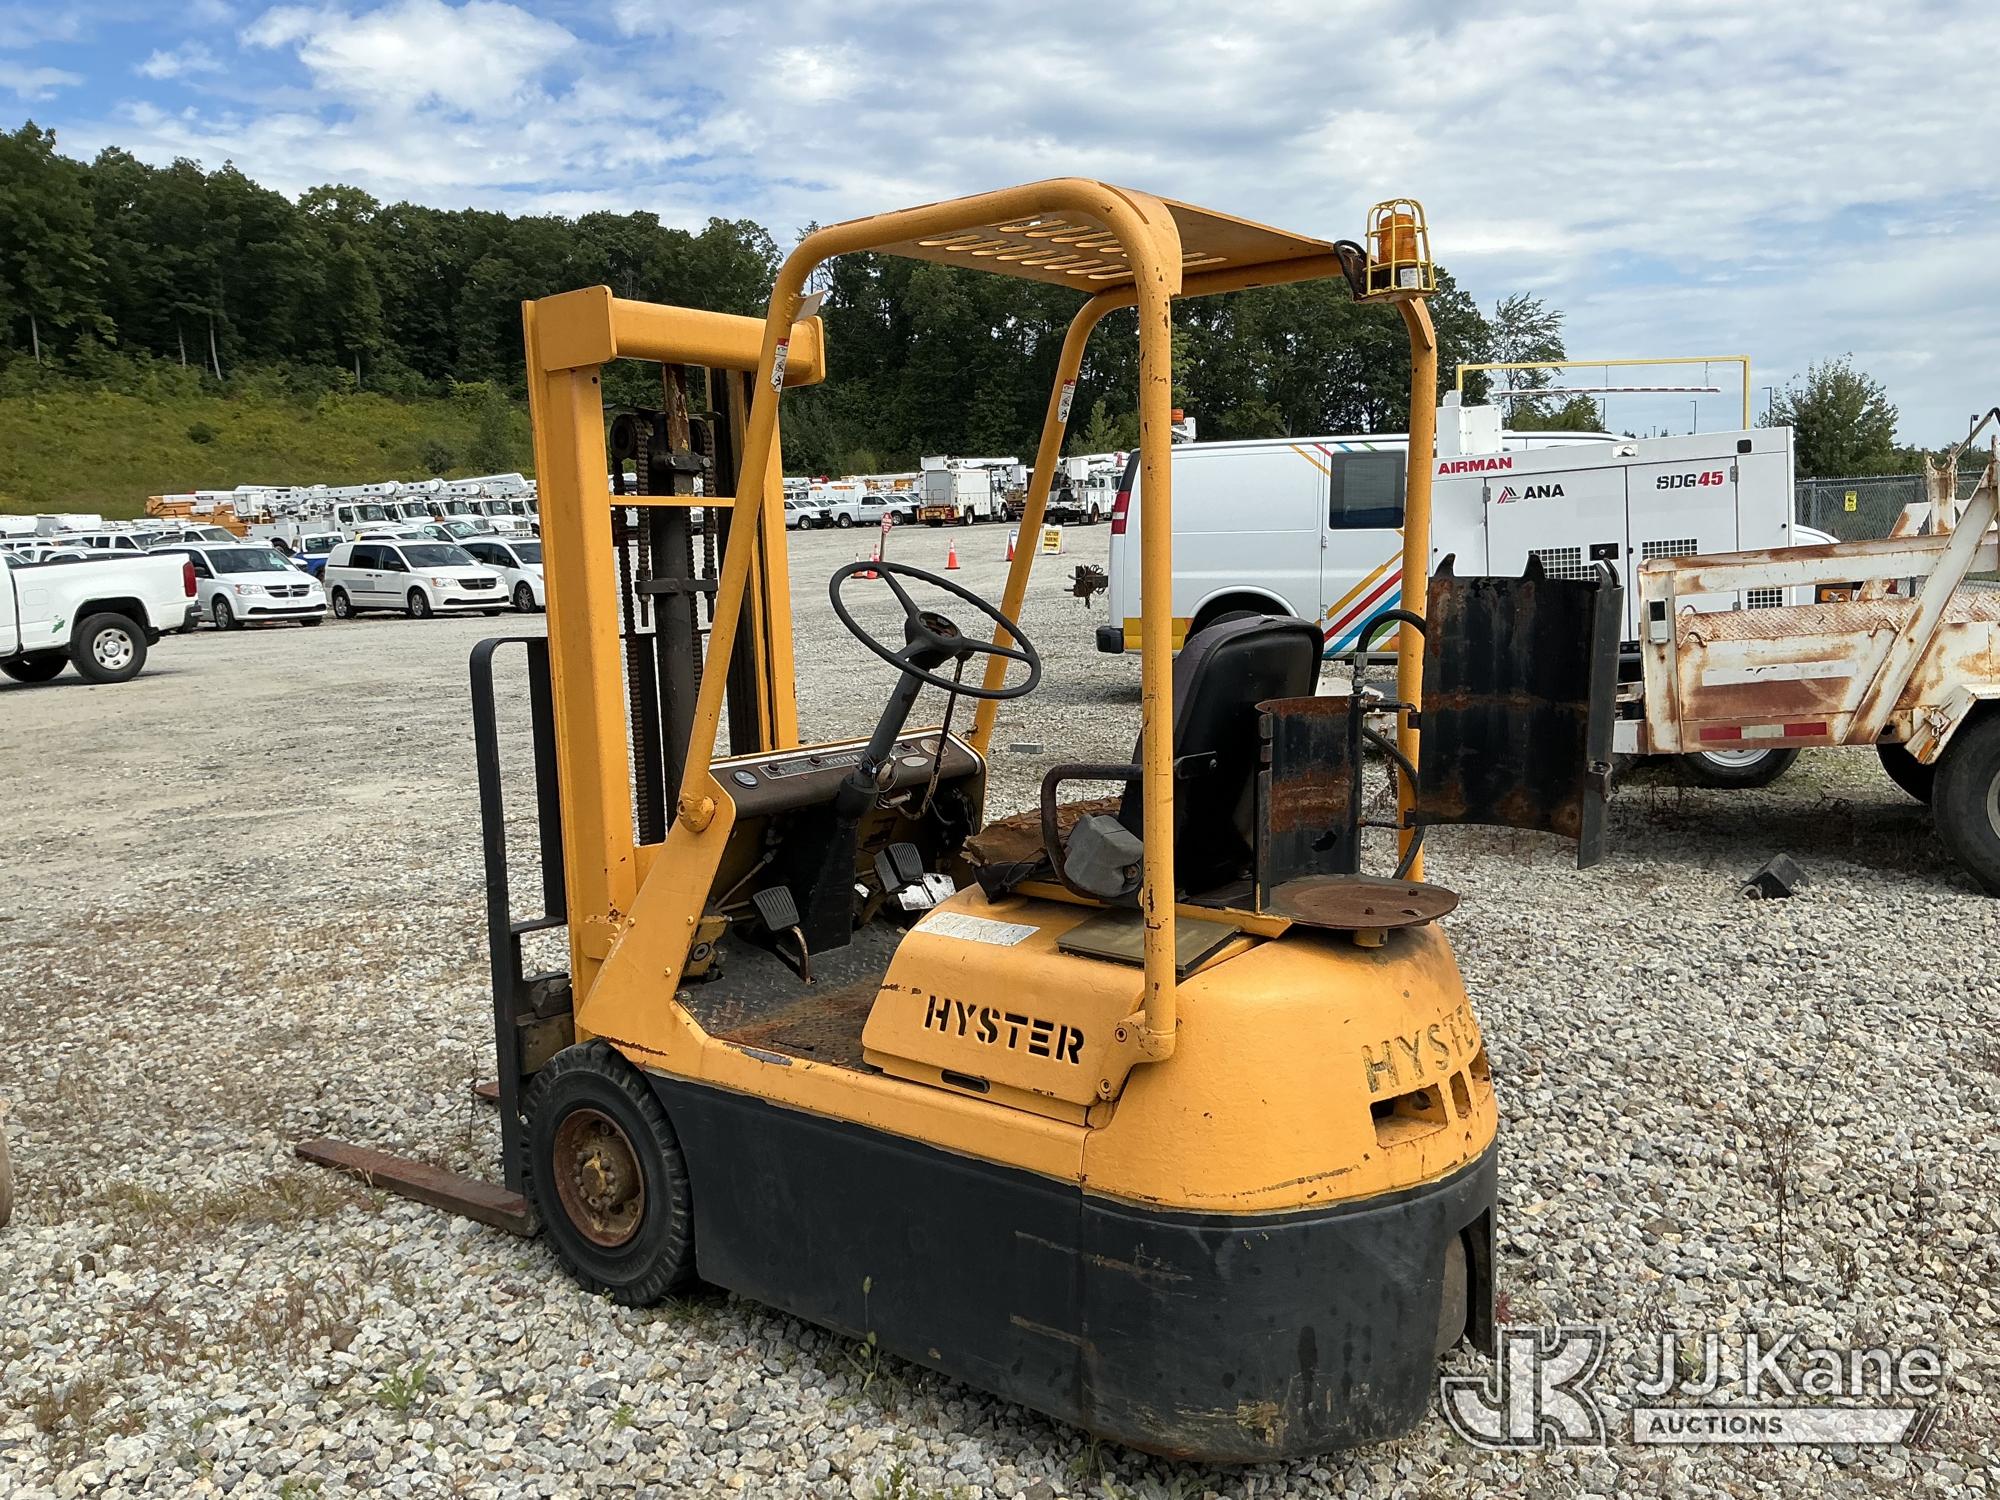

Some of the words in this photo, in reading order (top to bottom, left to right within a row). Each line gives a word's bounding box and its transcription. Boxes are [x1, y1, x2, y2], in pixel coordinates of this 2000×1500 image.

[1438, 457, 1512, 474] AIRMAN
[1524, 484, 1564, 499] ANA
[825, 755, 860, 765] HYSTER
[925, 995, 1084, 1064] HYSTER
[1361, 1004, 1475, 1093] HYSTE
